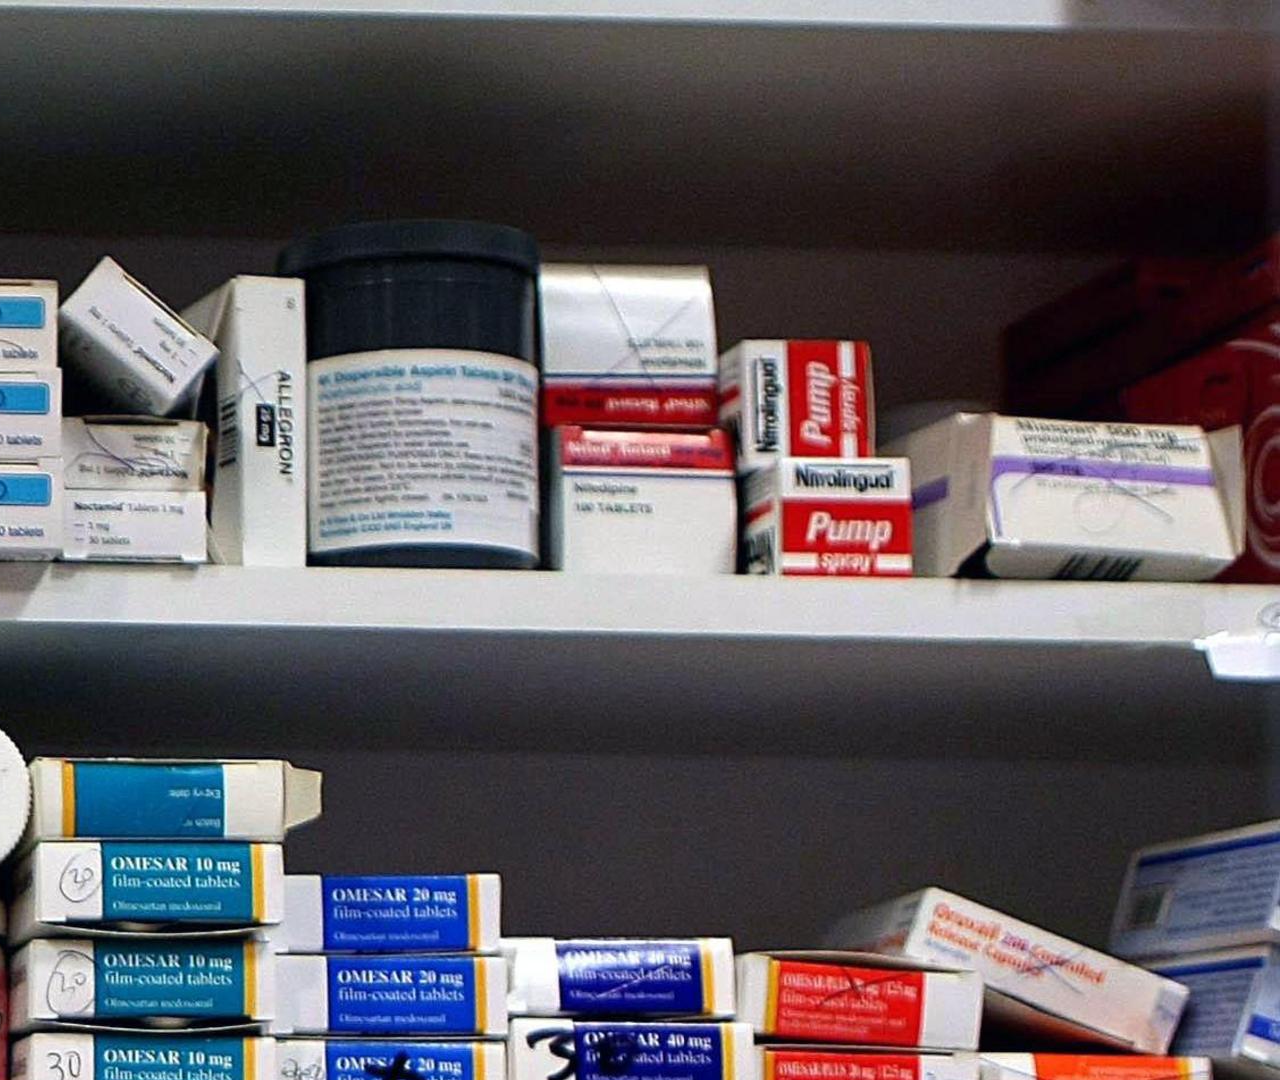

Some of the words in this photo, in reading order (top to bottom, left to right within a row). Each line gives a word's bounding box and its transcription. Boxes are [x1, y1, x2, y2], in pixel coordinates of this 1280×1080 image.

[802, 361, 838, 445] Pump
[276, 371, 293, 476] ALLEGRON
[795, 466, 894, 492] Nitrolingual
[9, 524, 44, 537] tablets
[807, 511, 892, 550] Pump
